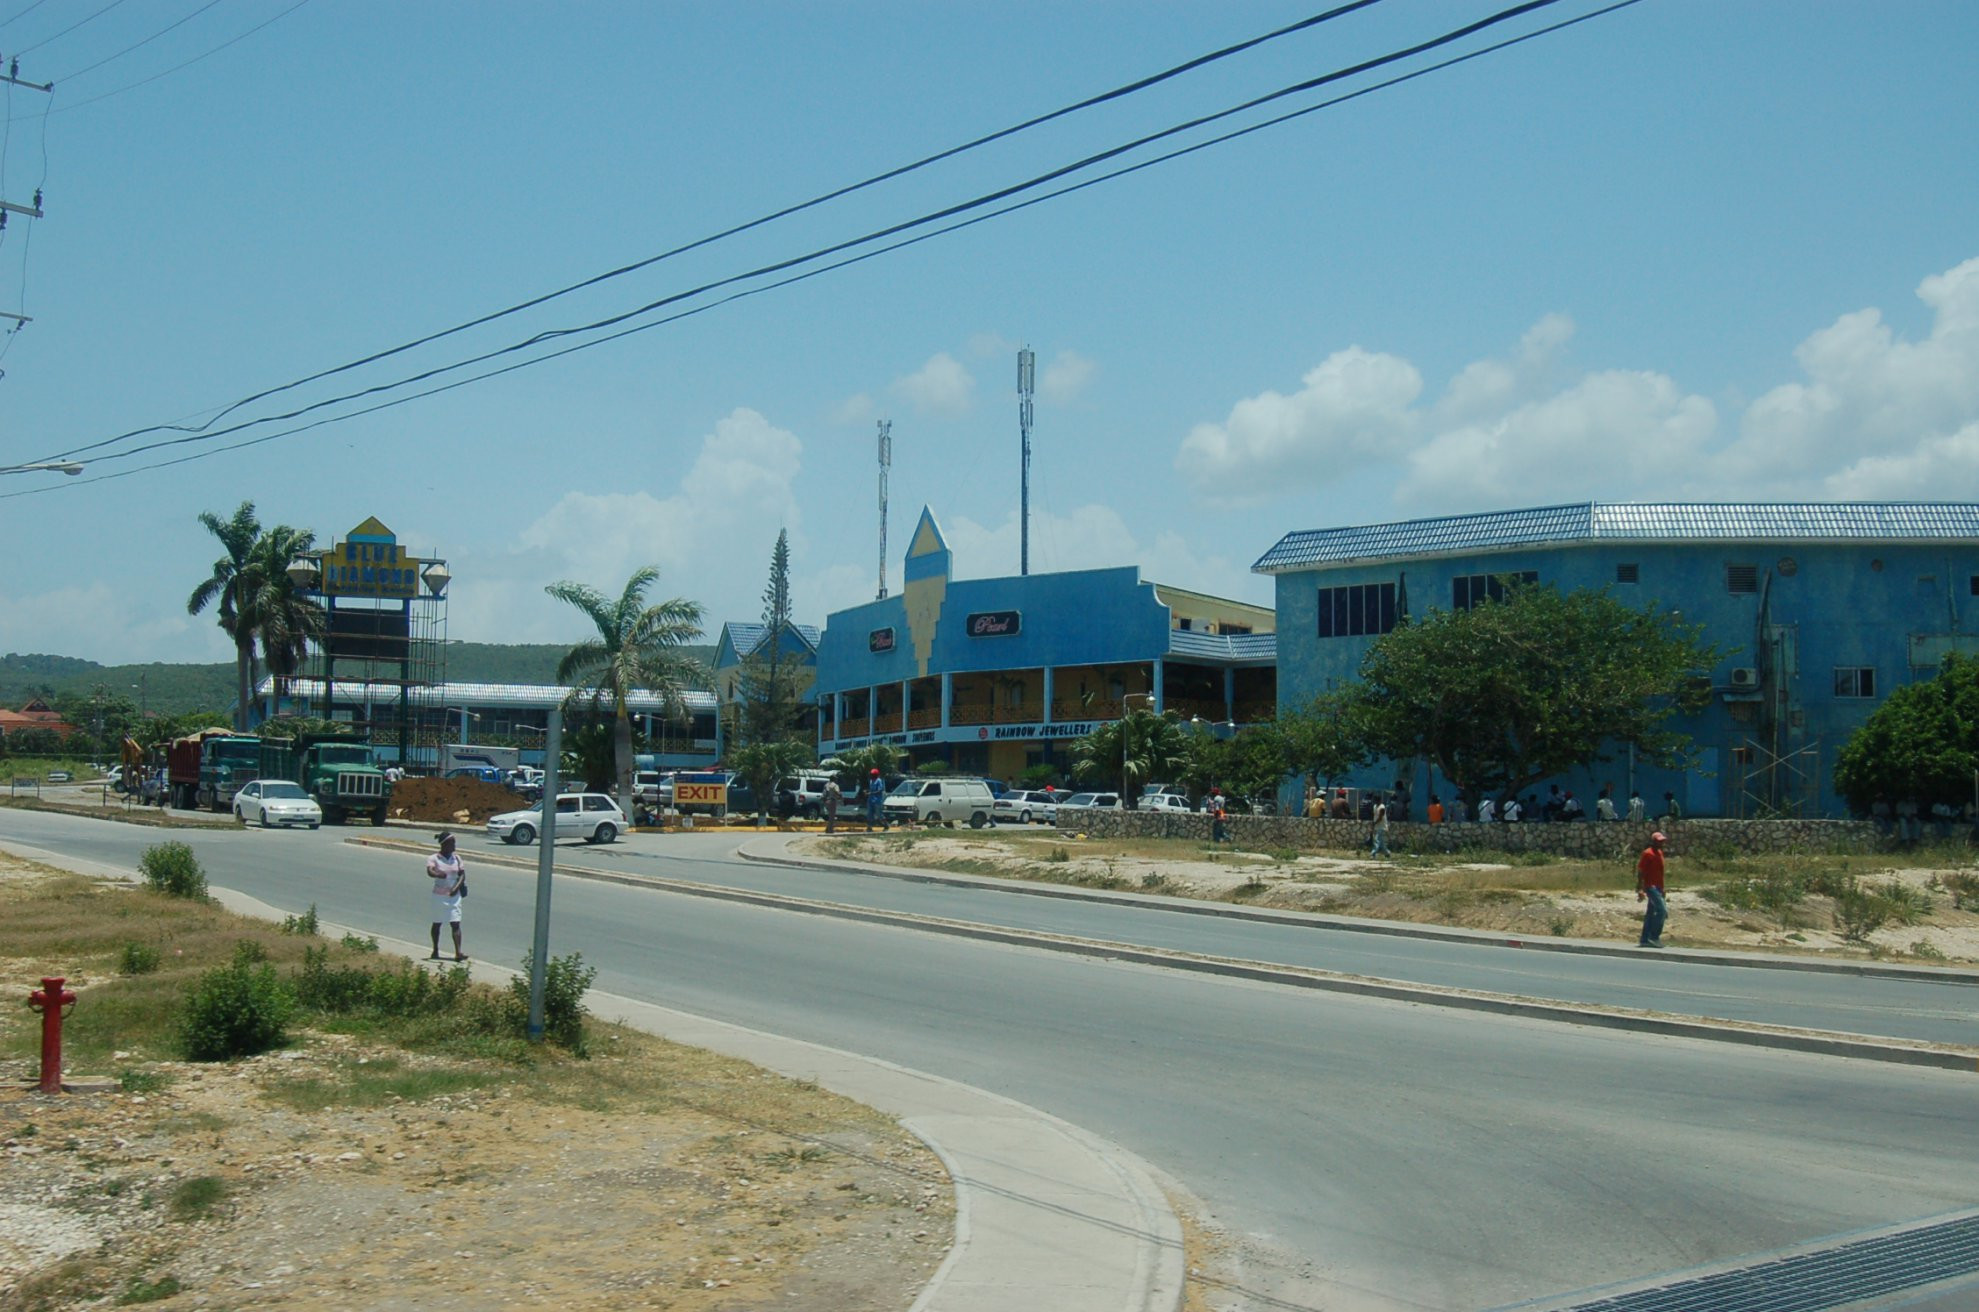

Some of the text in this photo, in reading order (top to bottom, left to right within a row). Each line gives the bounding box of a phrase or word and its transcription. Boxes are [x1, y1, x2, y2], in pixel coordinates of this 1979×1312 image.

[974, 616, 1010, 633] Pearl
[995, 724, 1092, 739] RAINBOW JEWELLERS
[678, 786, 722, 799] EXIT
